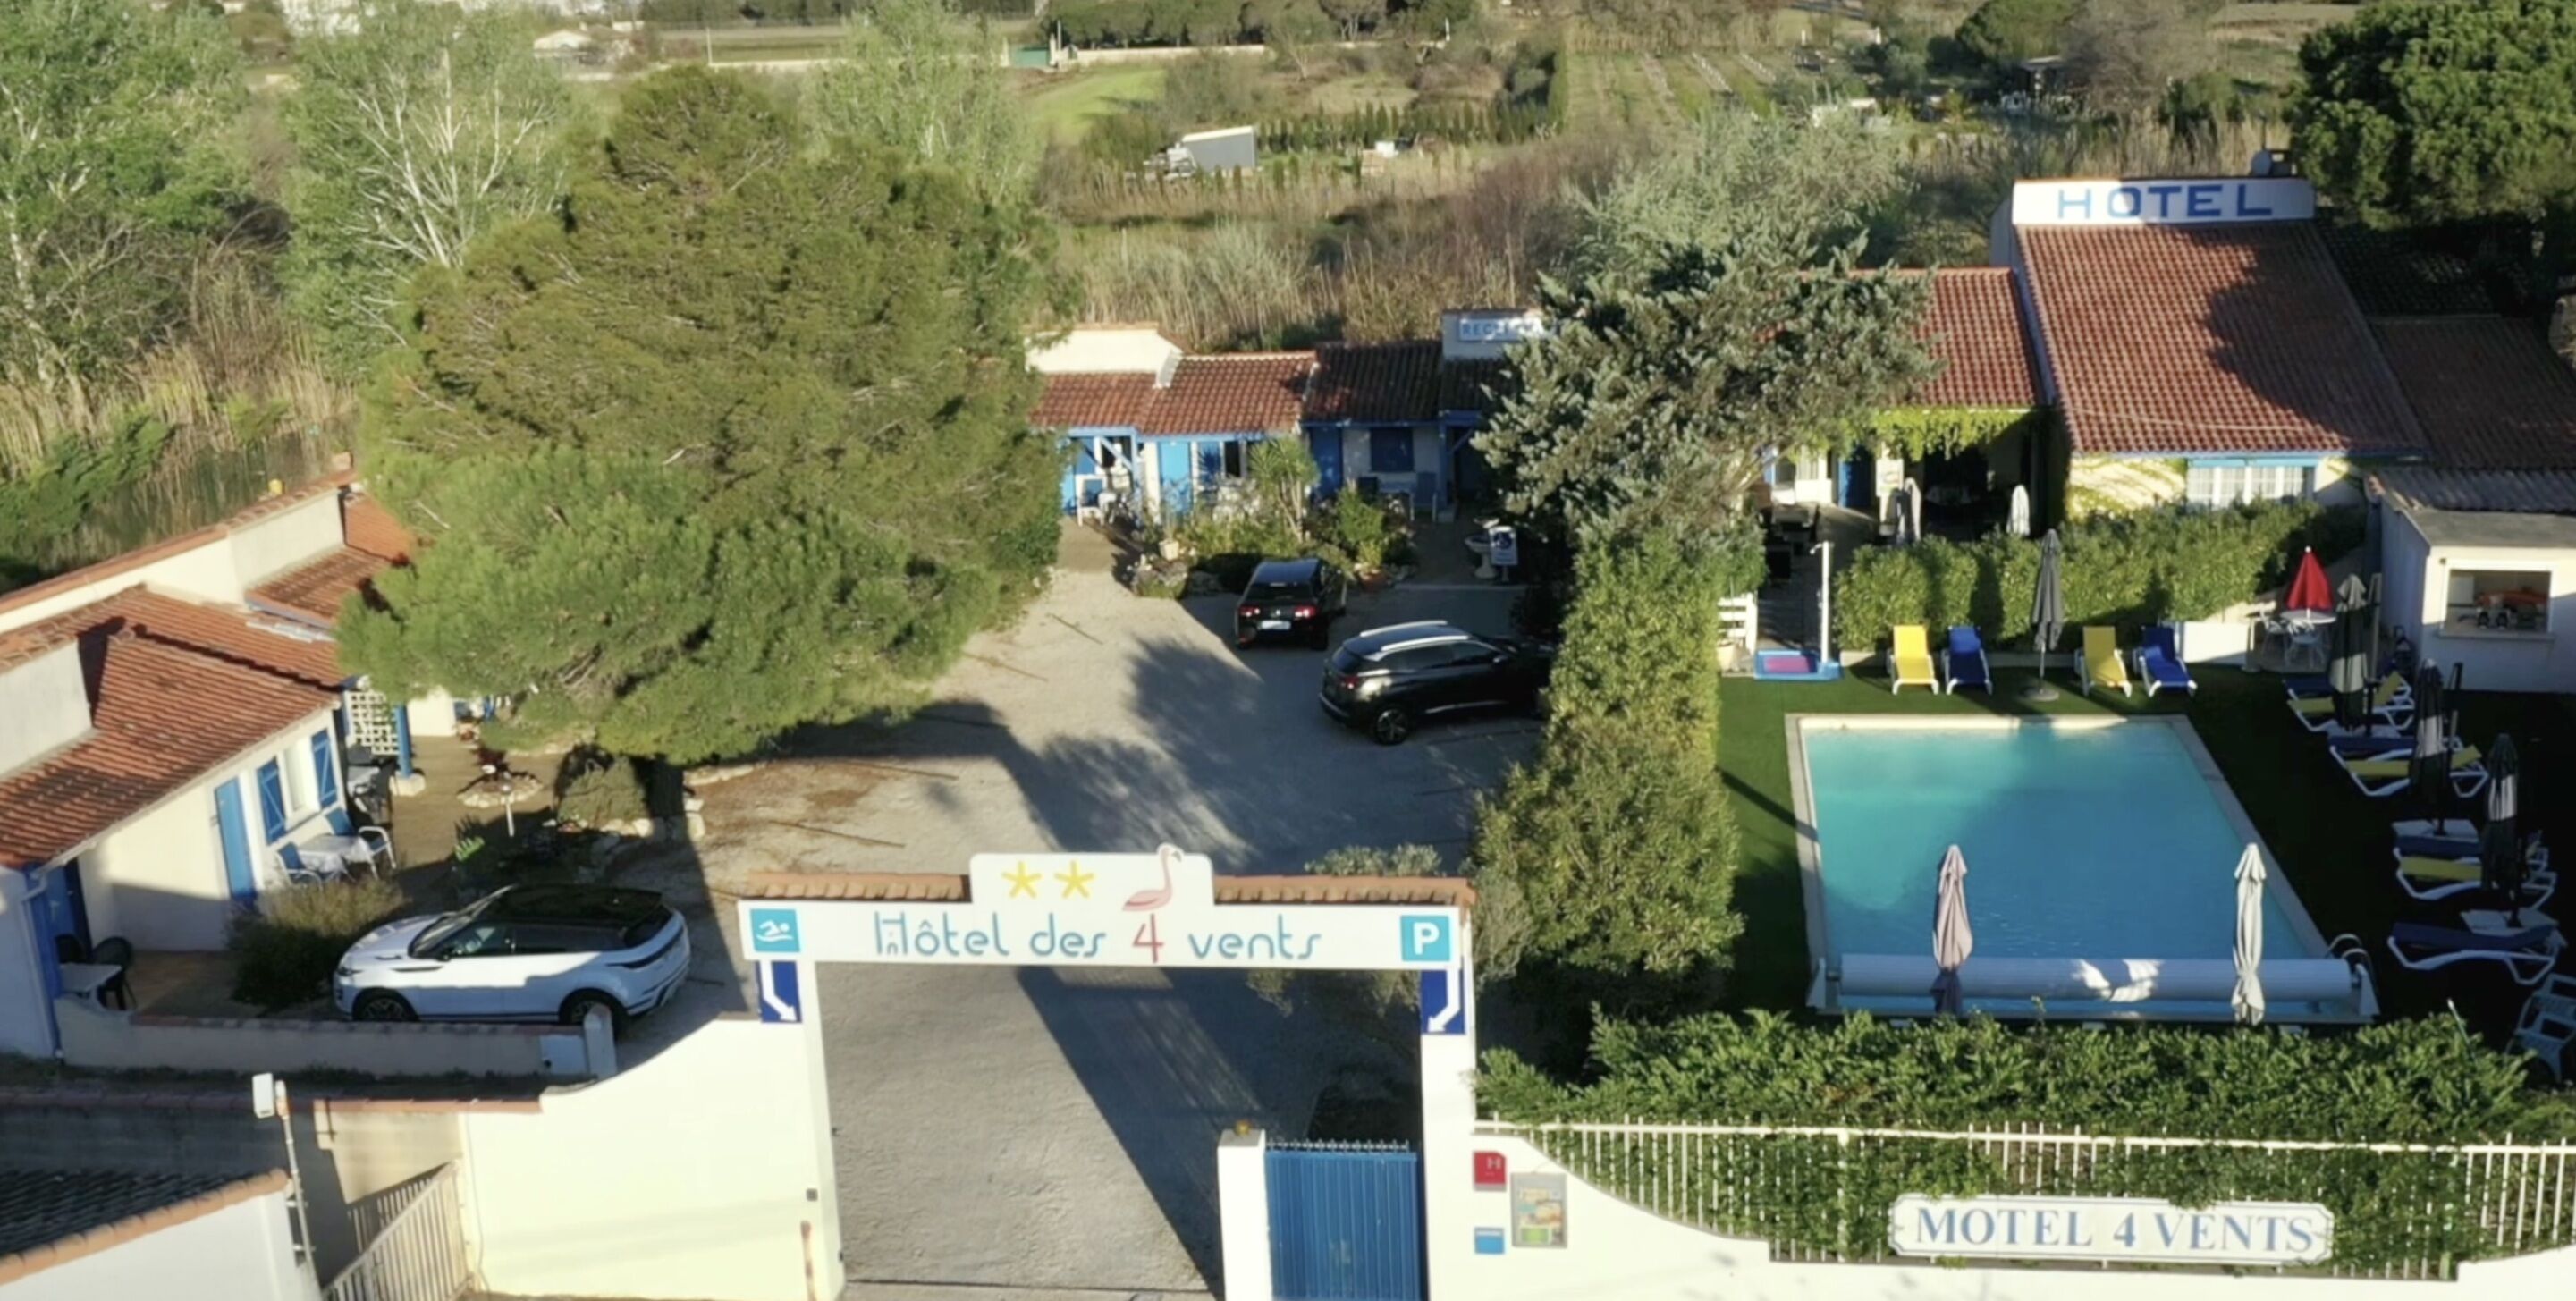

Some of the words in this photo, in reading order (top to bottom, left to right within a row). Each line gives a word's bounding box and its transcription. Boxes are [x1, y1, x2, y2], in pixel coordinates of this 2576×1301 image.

[2057, 183, 2273, 220] HOTEL
[875, 911, 1009, 957] Hôtel
[1029, 912, 1106, 958] des
[1132, 913, 1164, 964] 4
[1187, 914, 1322, 960] vents
[1413, 922, 1440, 955] P
[1916, 1207, 2093, 1247] MOTEL
[2113, 1212, 2136, 1248] 4
[2154, 1212, 2313, 1253] VENTS
